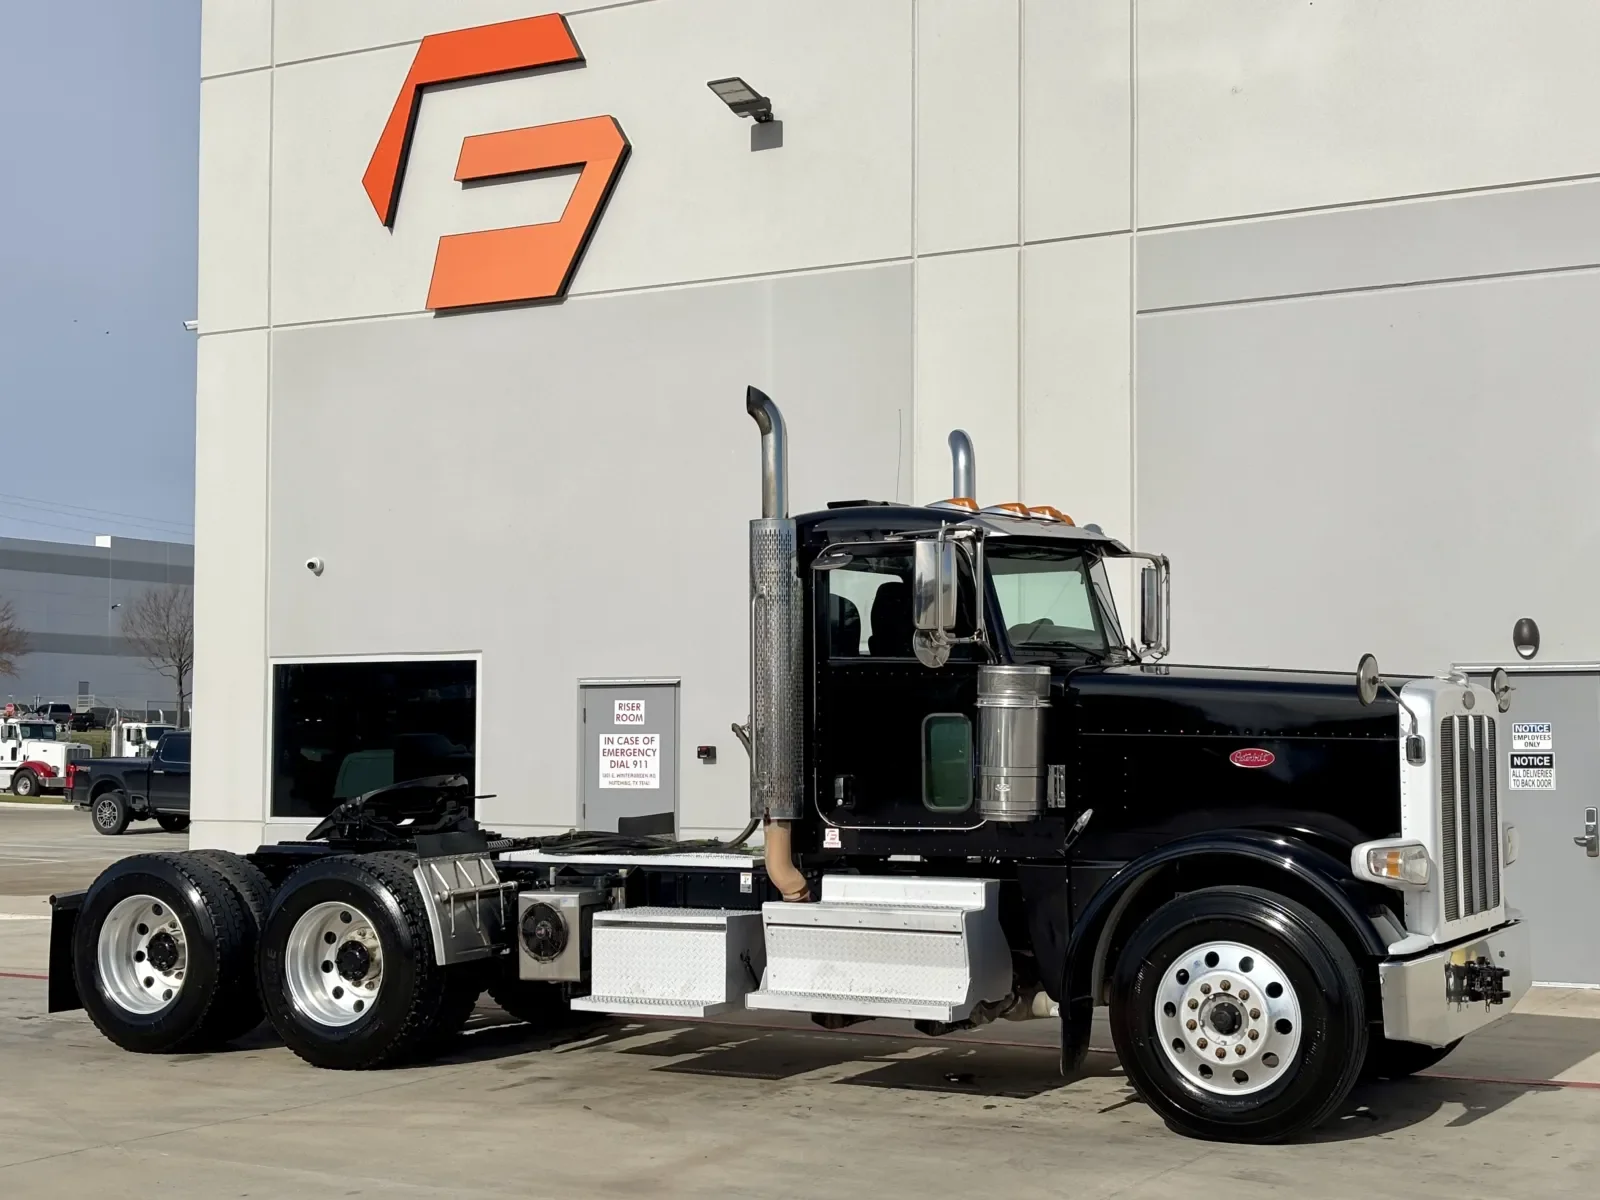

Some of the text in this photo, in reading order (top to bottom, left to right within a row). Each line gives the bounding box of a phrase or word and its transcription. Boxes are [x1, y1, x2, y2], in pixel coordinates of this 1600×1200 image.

[618, 702, 641, 712] RISER
[616, 713, 643, 722] ROOM
[1515, 724, 1549, 733] NOTICE
[604, 736, 655, 745] IN CASE OF
[602, 748, 657, 757] EMERGENCY
[610, 760, 648, 769] DIAL 911
[1513, 756, 1550, 766] NOTICE
[1512, 769, 1552, 778] ALL DELIVERIES
[1513, 779, 1552, 788] TO BACK DOOR
